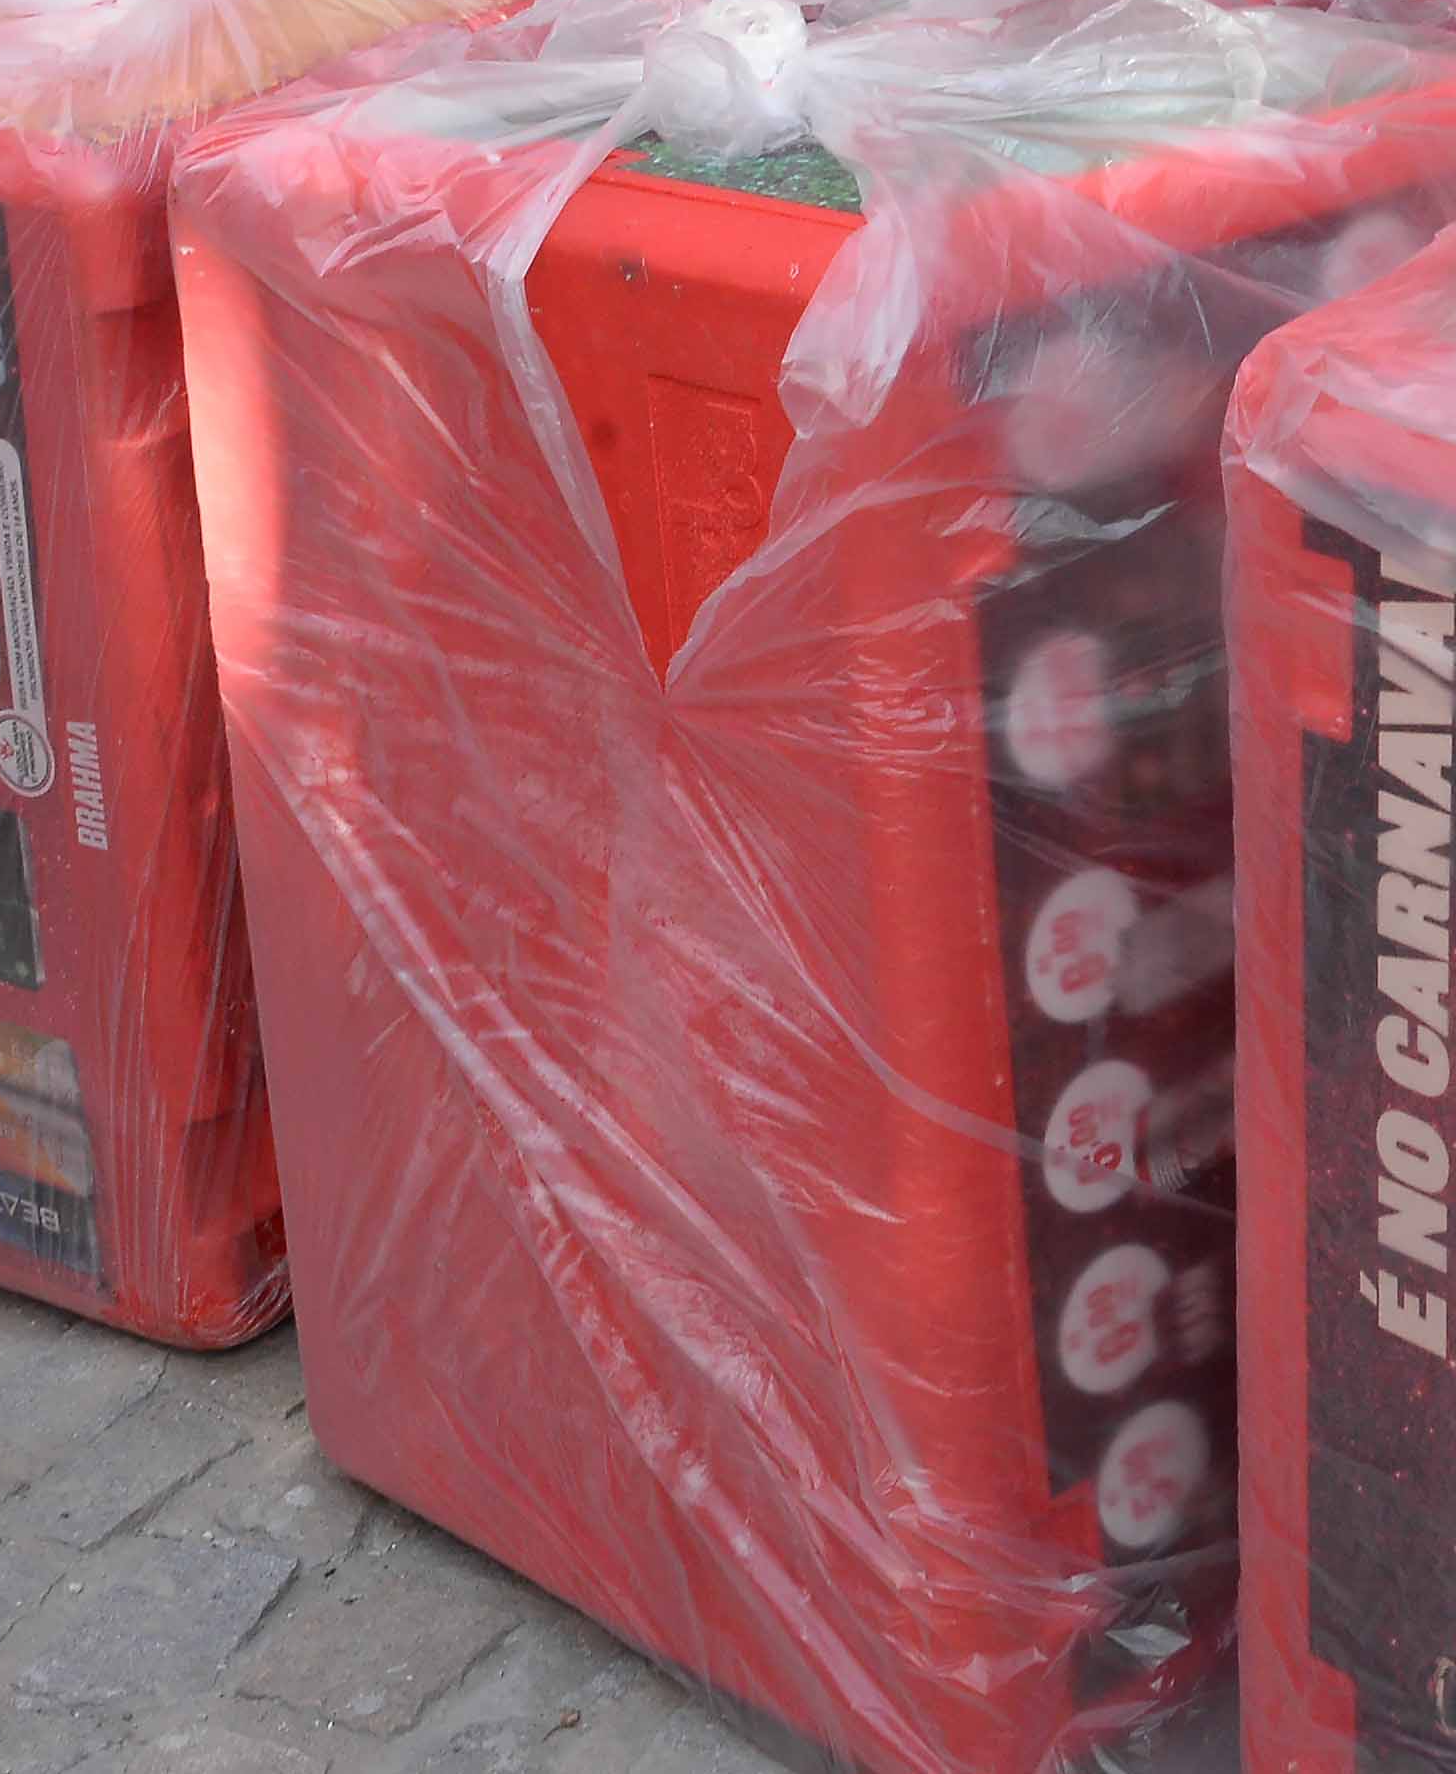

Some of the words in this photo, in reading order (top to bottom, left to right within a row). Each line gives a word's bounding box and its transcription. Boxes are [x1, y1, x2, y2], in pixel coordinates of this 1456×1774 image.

[65, 720, 109, 851] BRAHMA
[1376, 1110, 1451, 1275] NO
[1359, 1270, 1448, 1359] É
